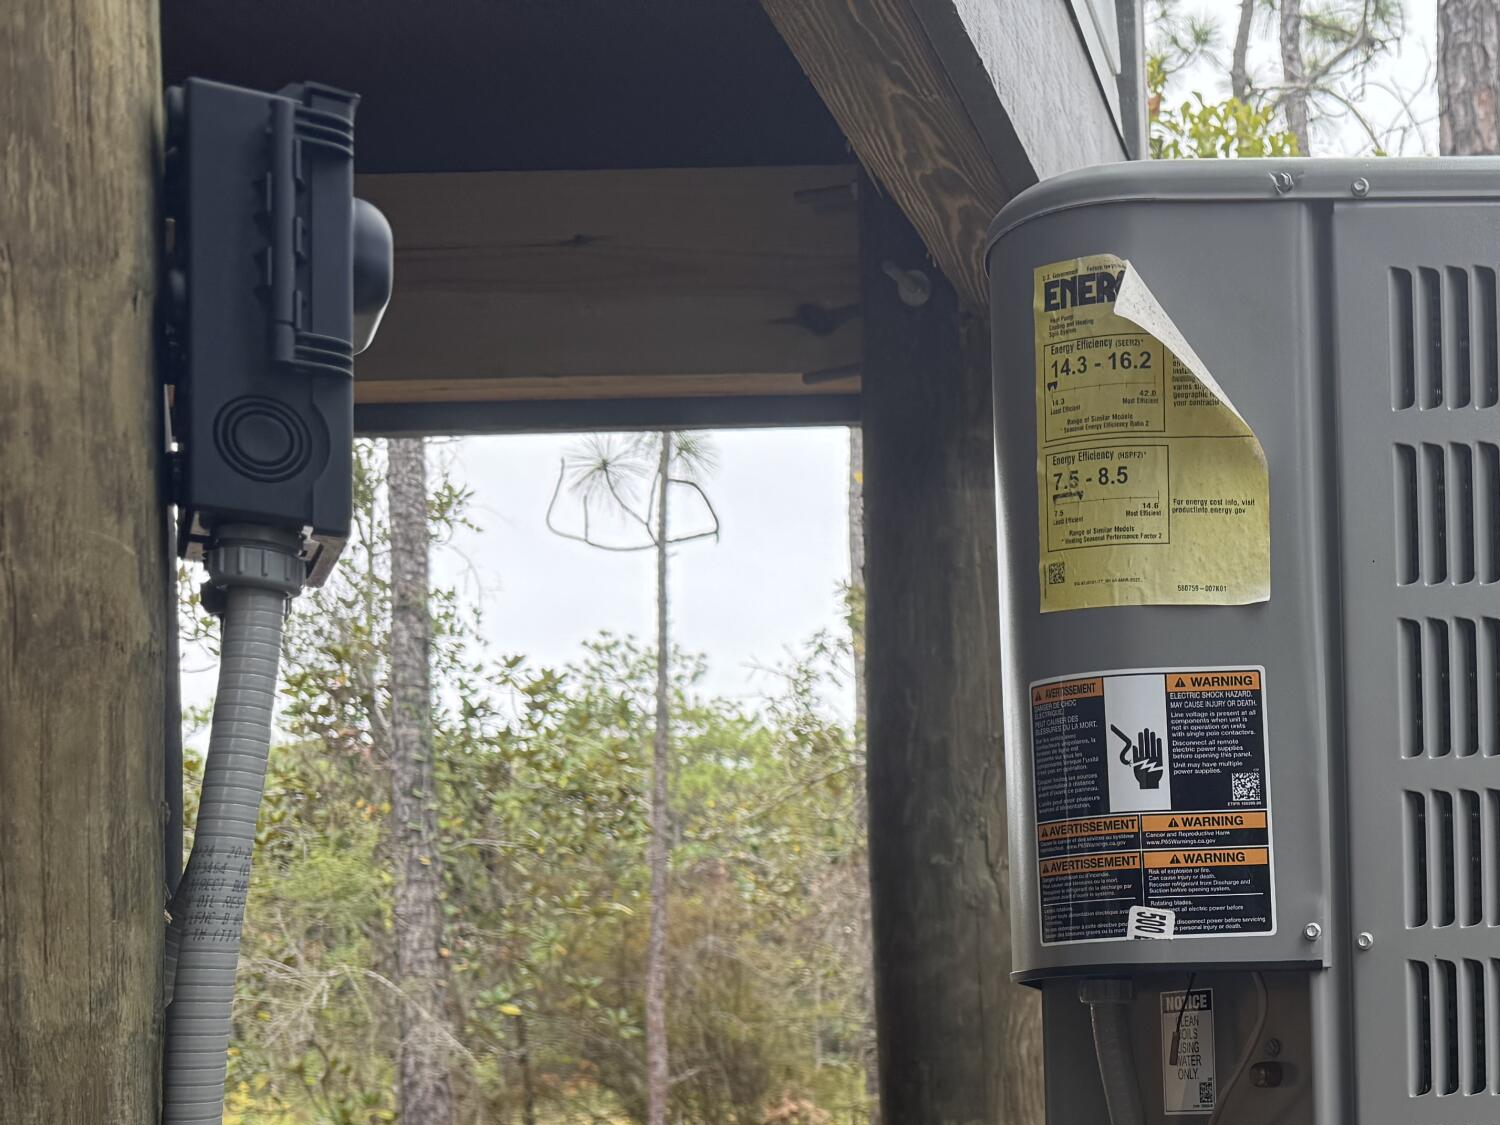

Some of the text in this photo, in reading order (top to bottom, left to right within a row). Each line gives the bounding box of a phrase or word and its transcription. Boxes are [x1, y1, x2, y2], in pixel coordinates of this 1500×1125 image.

[1051, 344, 1074, 355] Energy
[1077, 339, 1112, 350] Efficiency
[1051, 355, 1088, 378] 14.3
[1108, 351, 1151, 370] 16.2
[1052, 455, 1076, 466] Energy
[1078, 450, 1114, 462] Efficiency
[1053, 466, 1128, 491] 7.5 8.5
[1185, 499, 1208, 507] energy
[1046, 676, 1253, 698] AVERTISSEMENT WARNING
[1170, 690, 1253, 700] ELECTRIC SHOCK HAZARD.
[1170, 701, 1183, 709] MAY
[1183, 701, 1204, 709] CAUSE
[1205, 700, 1225, 708] INJURY
[1237, 699, 1257, 707] DEATH.
[1185, 711, 1208, 719] voltage
[1216, 710, 1240, 718] present
[1190, 724, 1220, 732] operation
[1194, 752, 1220, 760] opening
[1049, 815, 1244, 837] AVERTISSEMENT WARNING
[1178, 830, 1214, 838] Reproductive
[1146, 838, 1216, 846] www.P65Warnings.ca.gov
[1050, 852, 1246, 873] AVERTISSEMENT WARNING
[1167, 868, 1193, 876] explosion
[1171, 880, 1199, 888] refrigerant
[1213, 879, 1239, 887] Discharge
[1177, 1015, 1200, 1028] LEAN
[1180, 1028, 1198, 1040] OILS
[1178, 1067, 1200, 1080] ONLY.
